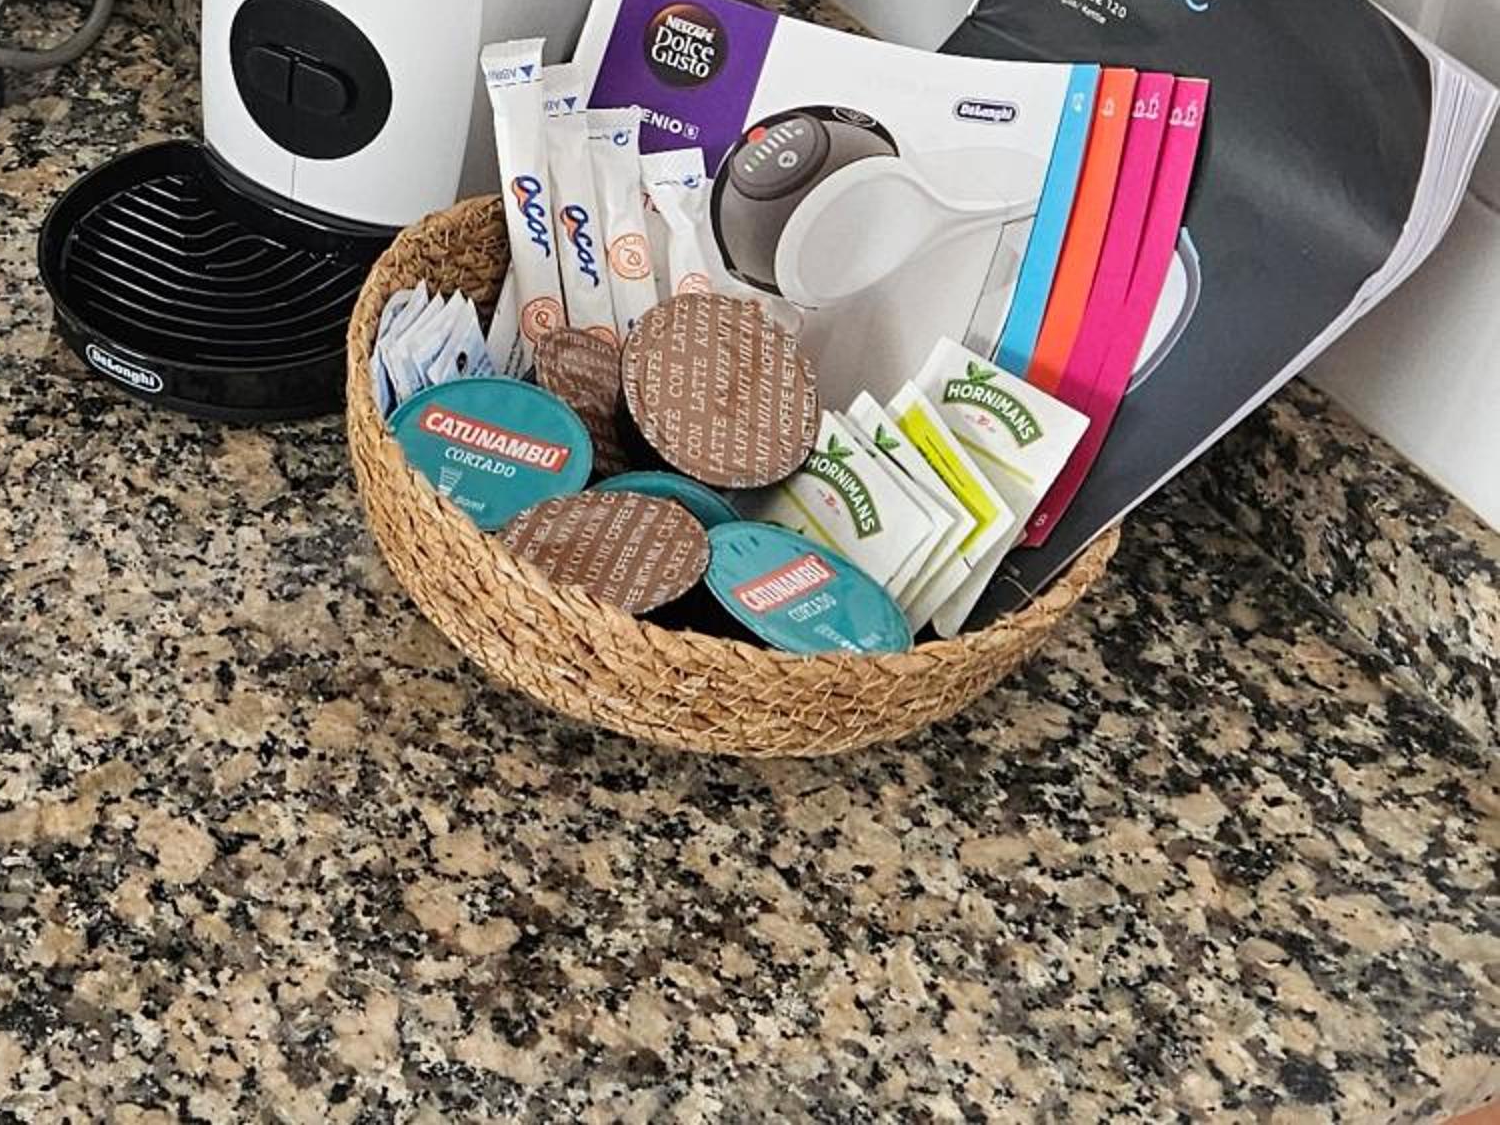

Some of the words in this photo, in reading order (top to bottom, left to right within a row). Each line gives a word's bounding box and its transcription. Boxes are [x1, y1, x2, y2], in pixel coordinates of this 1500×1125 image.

[1107, 0, 1128, 19] 120
[652, 44, 710, 78] Gusto
[655, 25, 715, 63] Dolce
[631, 105, 683, 134] ENIO
[672, 298, 689, 353] LATTE
[670, 362, 684, 397] CON
[692, 356, 707, 411] LATTE
[948, 383, 1035, 439] HORNIMANS
[687, 422, 703, 459] CON
[710, 416, 727, 474] LATTE
[445, 446, 517, 479] CORTADO
[806, 456, 875, 532] HORNIMANS
